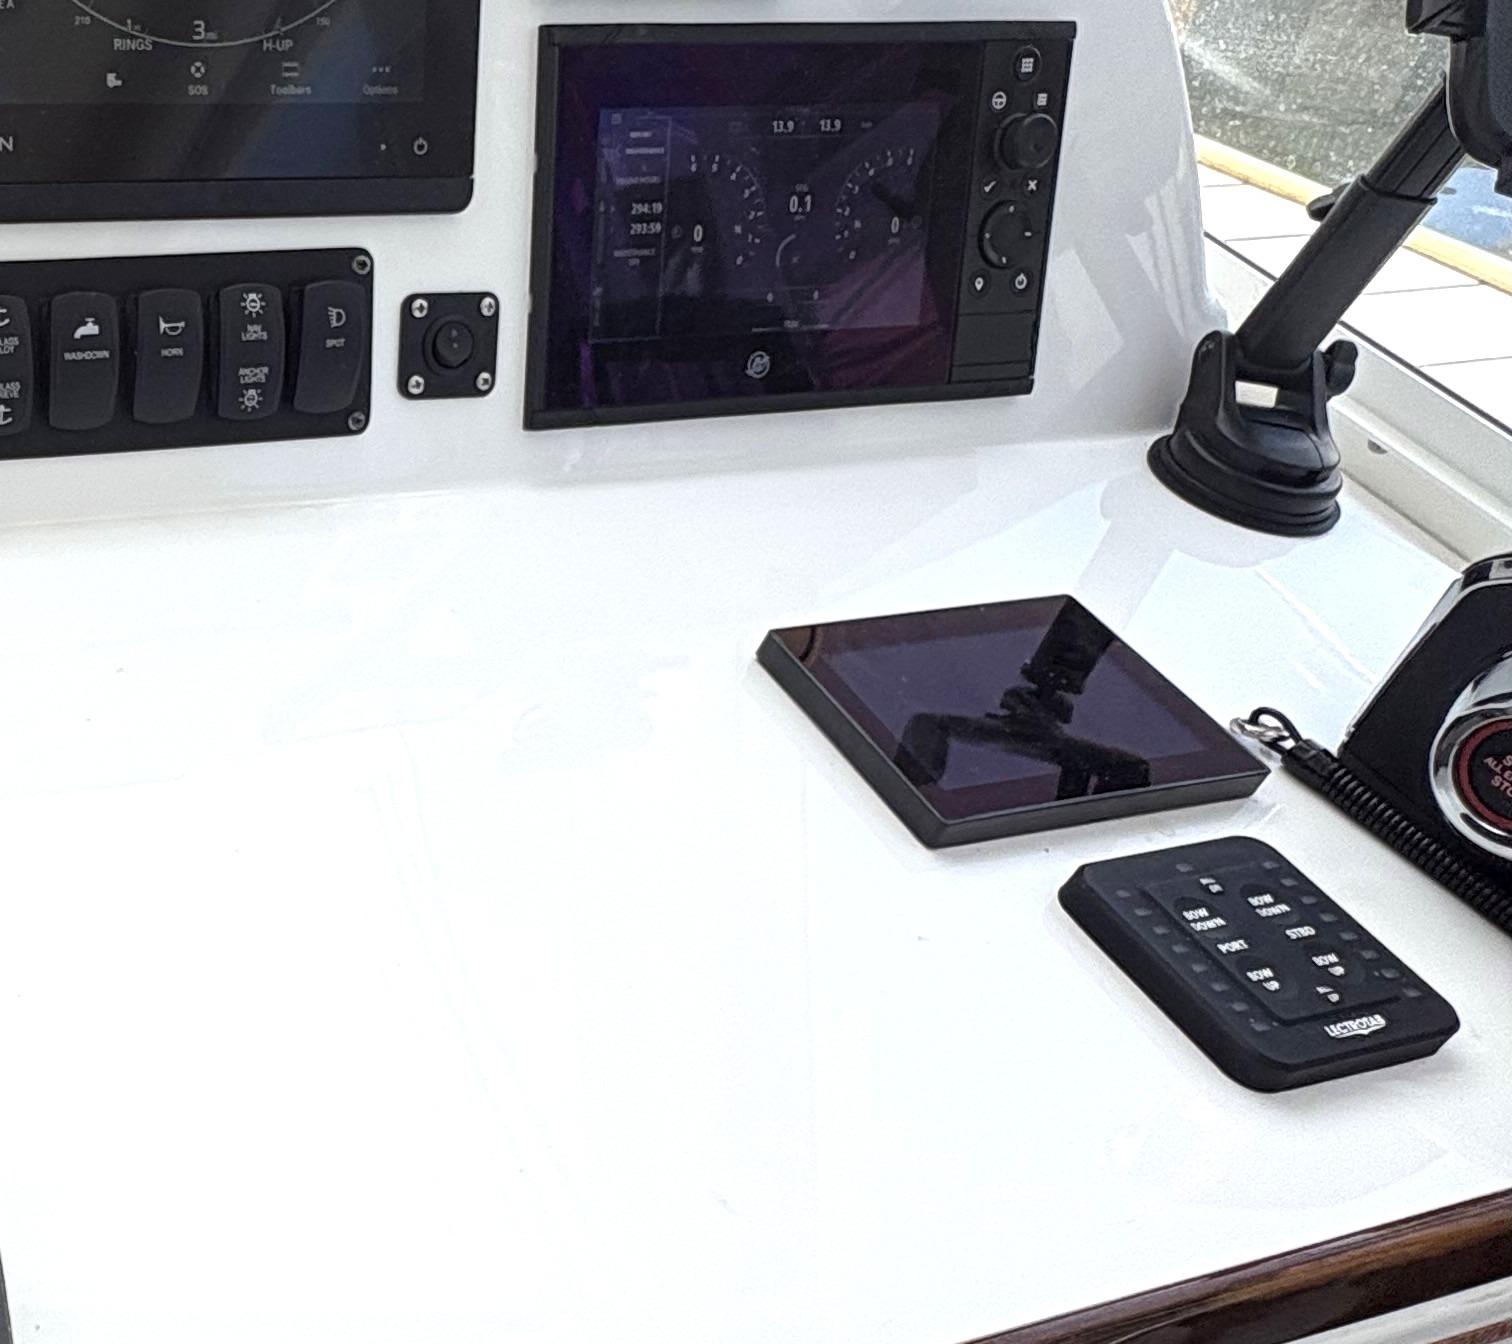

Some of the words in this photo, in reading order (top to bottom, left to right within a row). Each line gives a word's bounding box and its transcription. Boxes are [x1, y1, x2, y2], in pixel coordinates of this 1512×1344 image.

[113, 38, 153, 51] RINGS
[262, 39, 294, 52] H-UP
[187, 84, 209, 97] SOS
[789, 195, 812, 213] 0.1
[246, 324, 263, 334] NAV
[240, 332, 268, 342] LIGHTS
[63, 350, 111, 361] WASHDOWN
[161, 347, 184, 358] HORN
[238, 366, 269, 377] ANCHOR
[239, 375, 266, 384] LIGHTS
[1247, 893, 1275, 907] BOW
[1182, 907, 1210, 921] BOW
[1255, 903, 1292, 918] DOWN
[1190, 917, 1227, 932] DOWN
[1217, 939, 1249, 954] PORT
[1311, 952, 1339, 967] BOW
[1246, 967, 1275, 983] BOW
